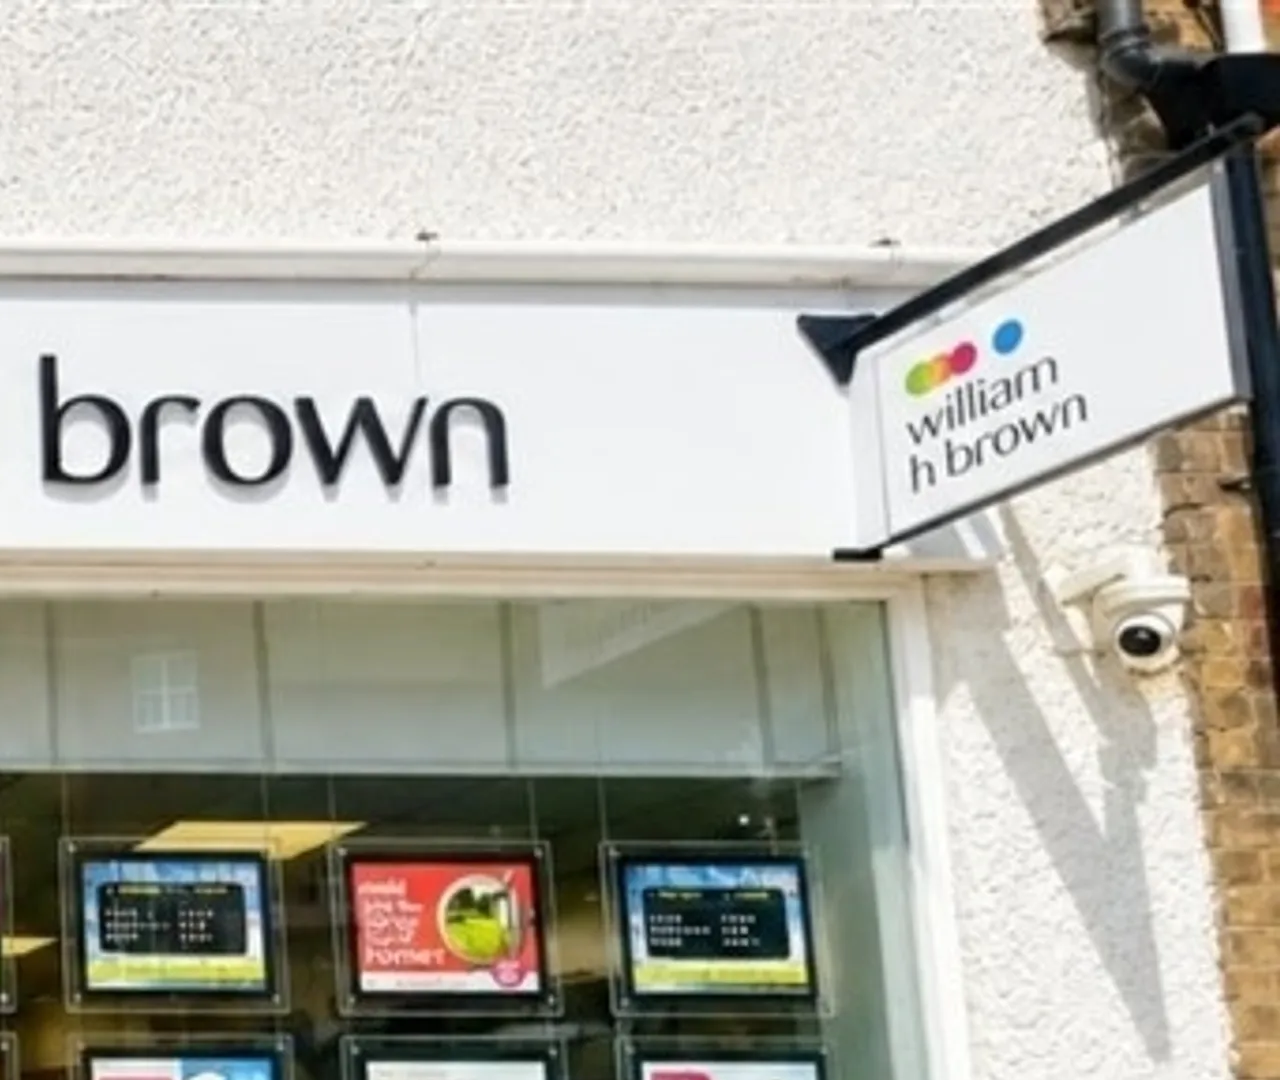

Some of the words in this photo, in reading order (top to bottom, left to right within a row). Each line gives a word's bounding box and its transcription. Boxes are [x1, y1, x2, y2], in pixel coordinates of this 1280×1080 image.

[40, 355, 509, 488] brown
[905, 355, 1059, 445] william
[909, 455, 937, 493] h
[944, 393, 1088, 478] brown
